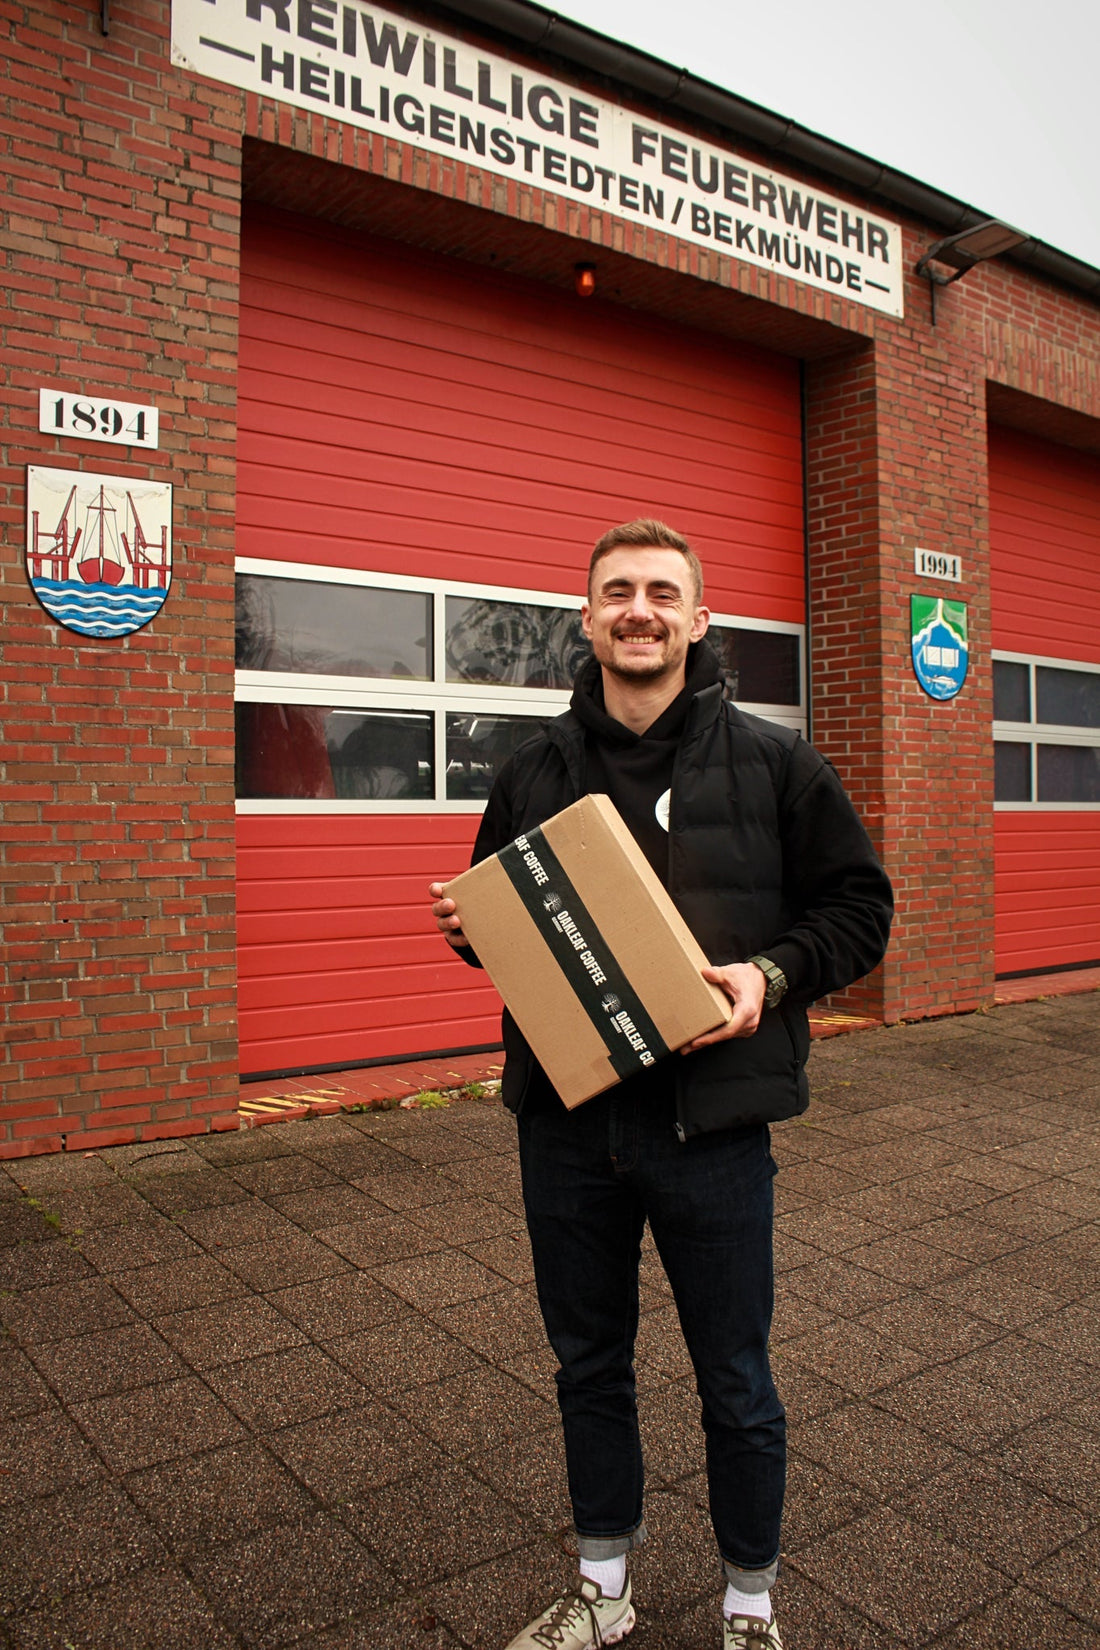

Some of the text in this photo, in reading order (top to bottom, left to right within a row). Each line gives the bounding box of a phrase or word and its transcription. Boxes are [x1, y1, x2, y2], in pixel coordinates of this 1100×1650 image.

[203, 0, 890, 264] REIWILLIGE FEUERWEHR
[50, 397, 149, 441] 1894
[919, 552, 958, 578] 1994
[523, 850, 550, 886] COFFEE
[557, 910, 588, 951] OAKLEAF
[580, 950, 607, 986] COFFEE
[615, 1010, 647, 1051] OAKLEAF
